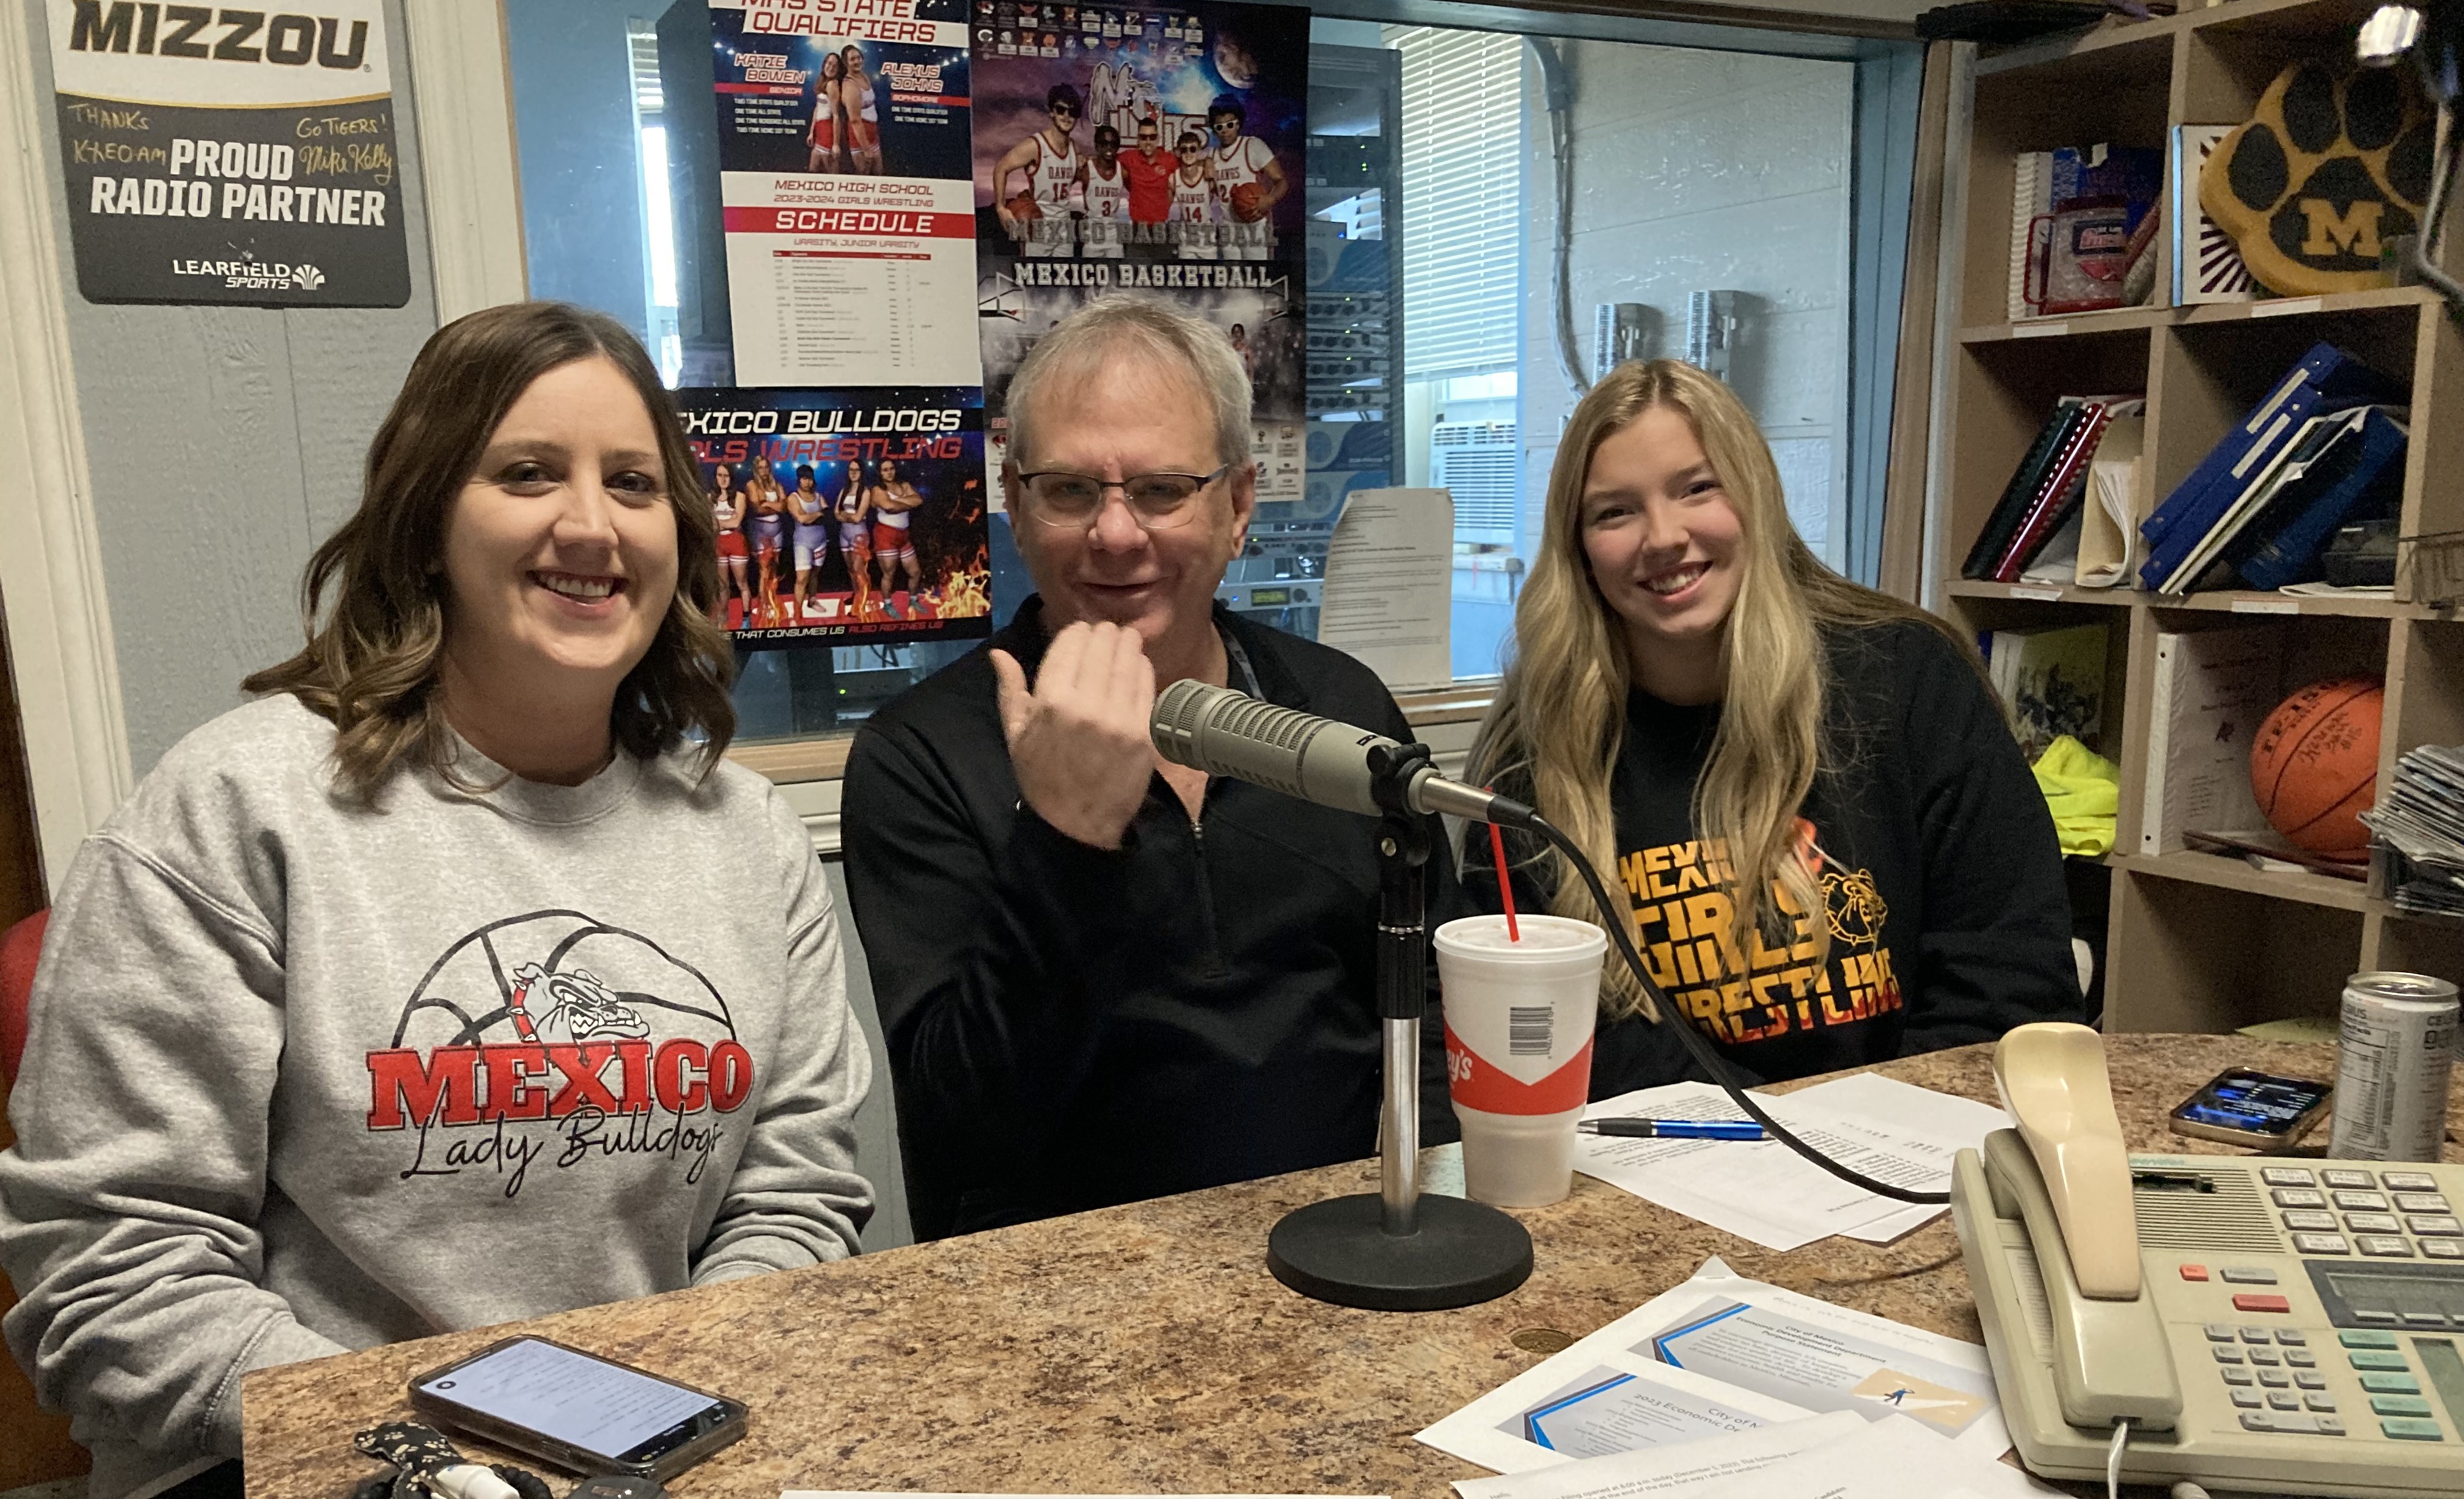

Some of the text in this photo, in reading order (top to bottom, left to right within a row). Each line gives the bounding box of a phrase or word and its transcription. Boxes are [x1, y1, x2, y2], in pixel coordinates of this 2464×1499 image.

[69, 0, 369, 70] MIZZOU
[753, 11, 936, 43] QUALIFIERS
[735, 54, 788, 68] KATIE
[881, 62, 941, 78] ALEXUS
[746, 68, 806, 84] BOWEN
[891, 77, 944, 92] JOHNS
[67, 103, 152, 130] THANKS
[296, 117, 321, 138] Go
[169, 139, 295, 181] PROUD
[775, 180, 934, 195] MEXICO HIGH SCHOOL
[90, 177, 386, 226] RADIO PARTNER
[774, 194, 934, 207] 2023-2024 GIRLS WRESTLING
[1102, 200, 1110, 216] 3
[776, 210, 934, 233] SCHEDULE
[1186, 207, 1202, 222] 14
[1008, 219, 1106, 243] MEXICO
[2300, 197, 2385, 257] M
[840, 239, 877, 247] JUNIOR
[172, 260, 291, 277] LEARFIELD
[1014, 263, 1272, 288] MEXICO BASKETBALL
[225, 276, 291, 290] SPORTS
[676, 409, 962, 434] XICO BULLDOGS
[689, 437, 963, 463] RLS WRESTLING
[736, 631, 765, 639] THAT
[766, 627, 828, 639] CONSUMES
[829, 626, 845, 636] US
[848, 624, 879, 634] ALSO
[367, 1038, 754, 1131] MEXICO
[400, 1102, 724, 1198] Lady Bulldogs
[1736, 1316, 1775, 1332] Economic
[1776, 1328, 1832, 1347] Development
[1834, 1344, 1887, 1364] Department
[1762, 1330, 1797, 1343] Purpose
[1797, 1340, 1842, 1357] Statement
[1785, 1325, 1802, 1335] City
[1814, 1334, 1844, 1346] Mexico
[1634, 1394, 1662, 1406] 2023
[1662, 1402, 1725, 1428] Economic
[1709, 1408, 1734, 1420] City
[1583, 1487, 1610, 1497] opened
[1652, 1475, 1673, 1485] today
